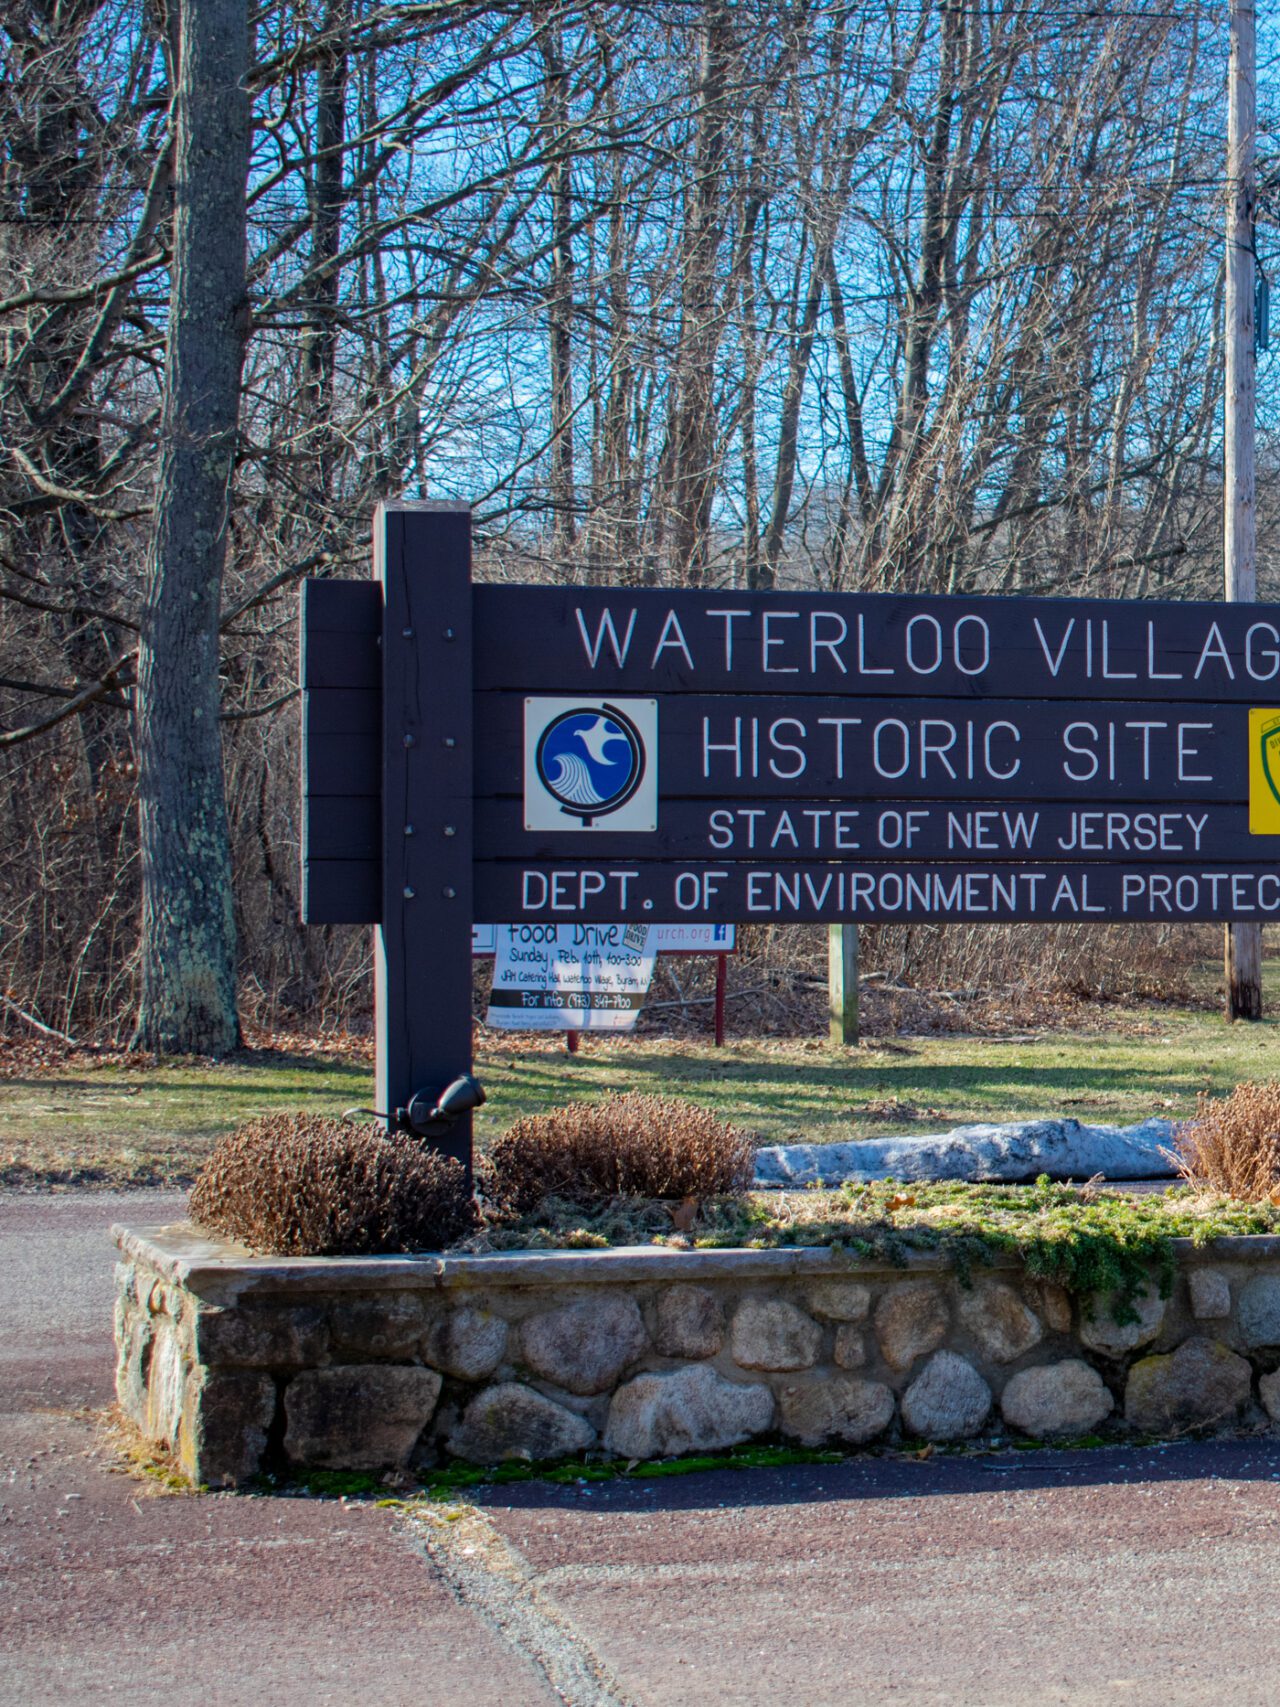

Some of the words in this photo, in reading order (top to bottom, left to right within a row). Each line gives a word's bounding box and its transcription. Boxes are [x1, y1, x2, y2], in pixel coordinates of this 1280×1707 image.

[574, 607, 990, 676] WATERLOO
[702, 715, 1021, 780] HISTORIC
[1062, 721, 1214, 782] SITE
[708, 809, 860, 849] STATE
[877, 810, 931, 849] OF
[947, 811, 1040, 850] NEW
[1056, 812, 1210, 851] JERSEY
[521, 870, 653, 911] DEPT.
[674, 871, 729, 911] OF
[746, 871, 1107, 913] ENVIRONMENTAL
[508, 923, 558, 944] Food
[572, 923, 620, 947] Drive
[509, 947, 554, 972] Sunday,
[557, 949, 579, 964] Feb.
[521, 992, 538, 1007] For
